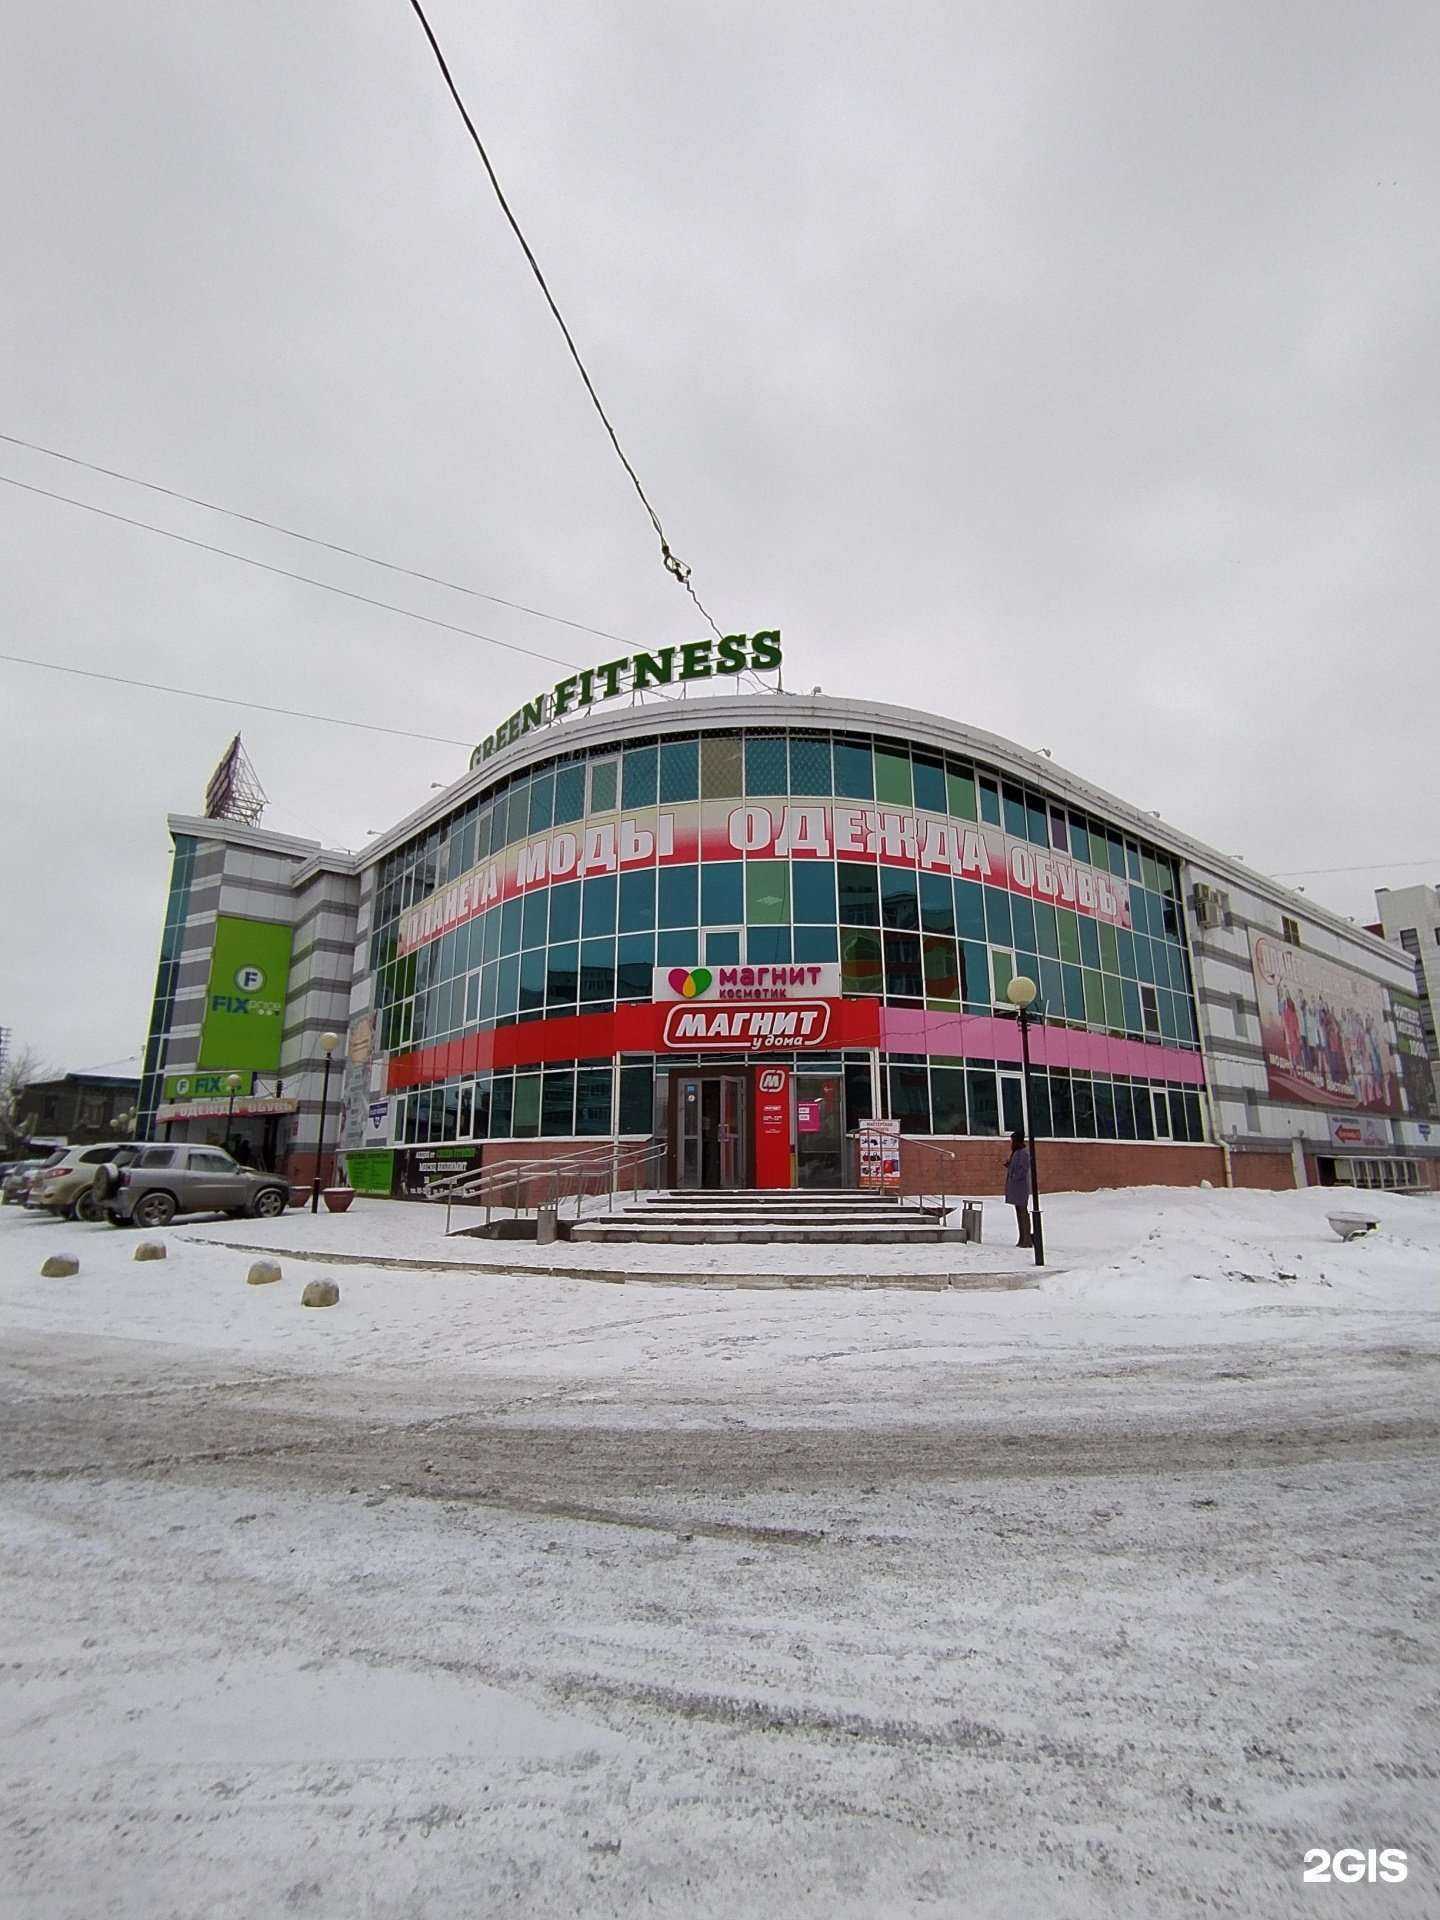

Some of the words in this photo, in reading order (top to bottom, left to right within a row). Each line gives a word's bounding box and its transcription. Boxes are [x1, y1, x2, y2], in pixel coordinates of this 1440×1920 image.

[469, 693, 548, 771] GREEN
[553, 630, 782, 717] FITNESS
[406, 862, 498, 946] ПЛАНЕТА
[516, 813, 675, 887] МОДЫ
[727, 805, 992, 877] ОДЕЖДА
[1008, 845, 1118, 916] ОБУВЬ
[212, 995, 248, 1014] FIX
[675, 1011, 818, 1037] МАГНИТ
[752, 1036, 763, 1050] у
[765, 1034, 803, 1047] дома
